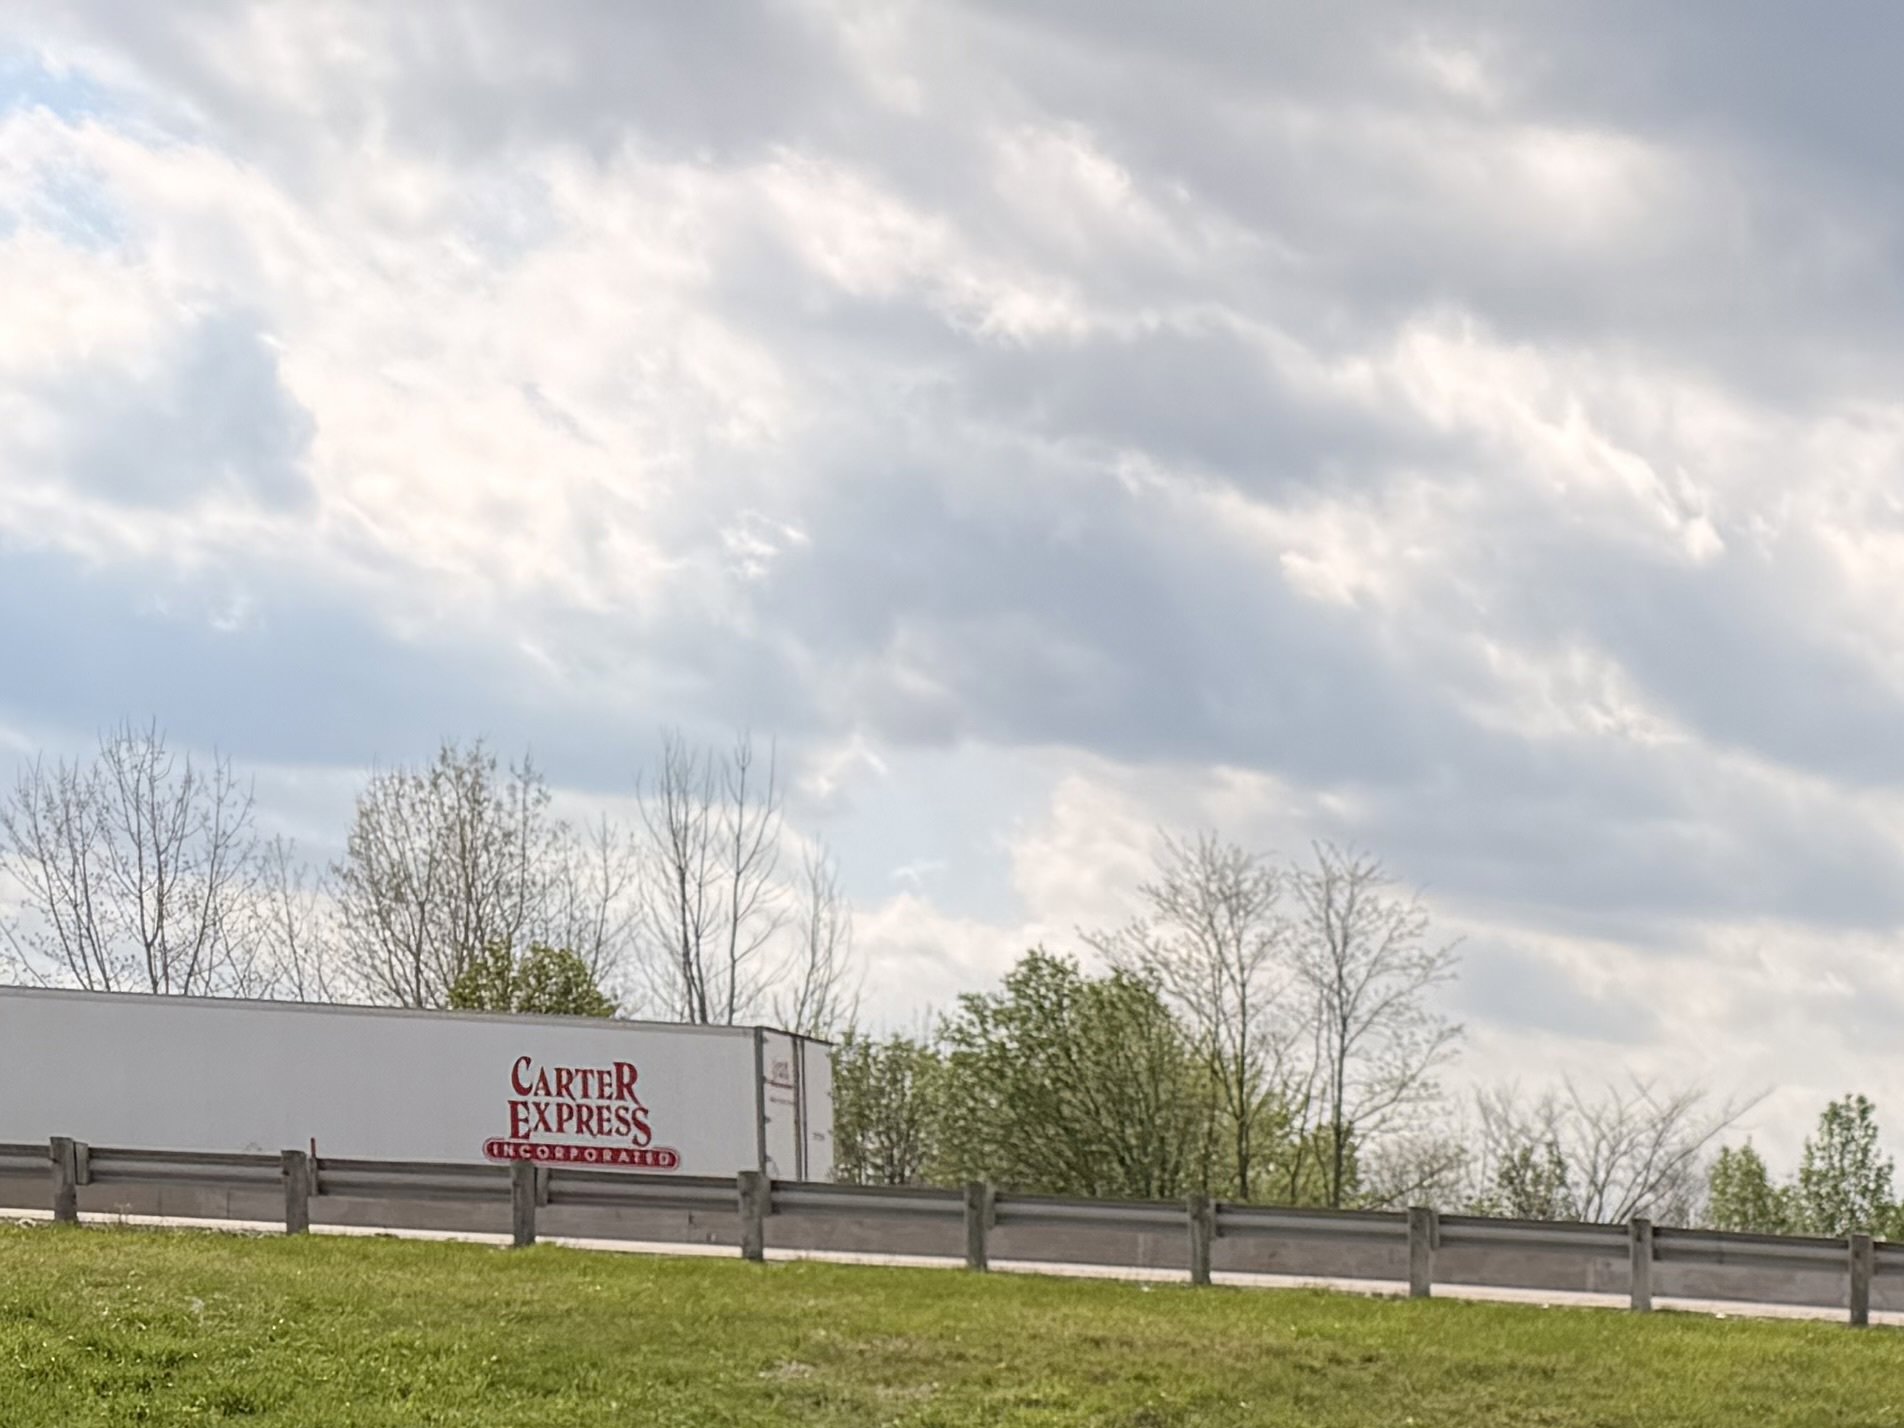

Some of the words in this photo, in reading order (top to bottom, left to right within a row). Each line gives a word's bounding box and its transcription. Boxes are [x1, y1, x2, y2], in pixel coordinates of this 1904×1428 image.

[511, 1056, 641, 1105] CARTER
[508, 1100, 652, 1147] EXPRESS
[492, 1143, 671, 1166] INCORPORATED
